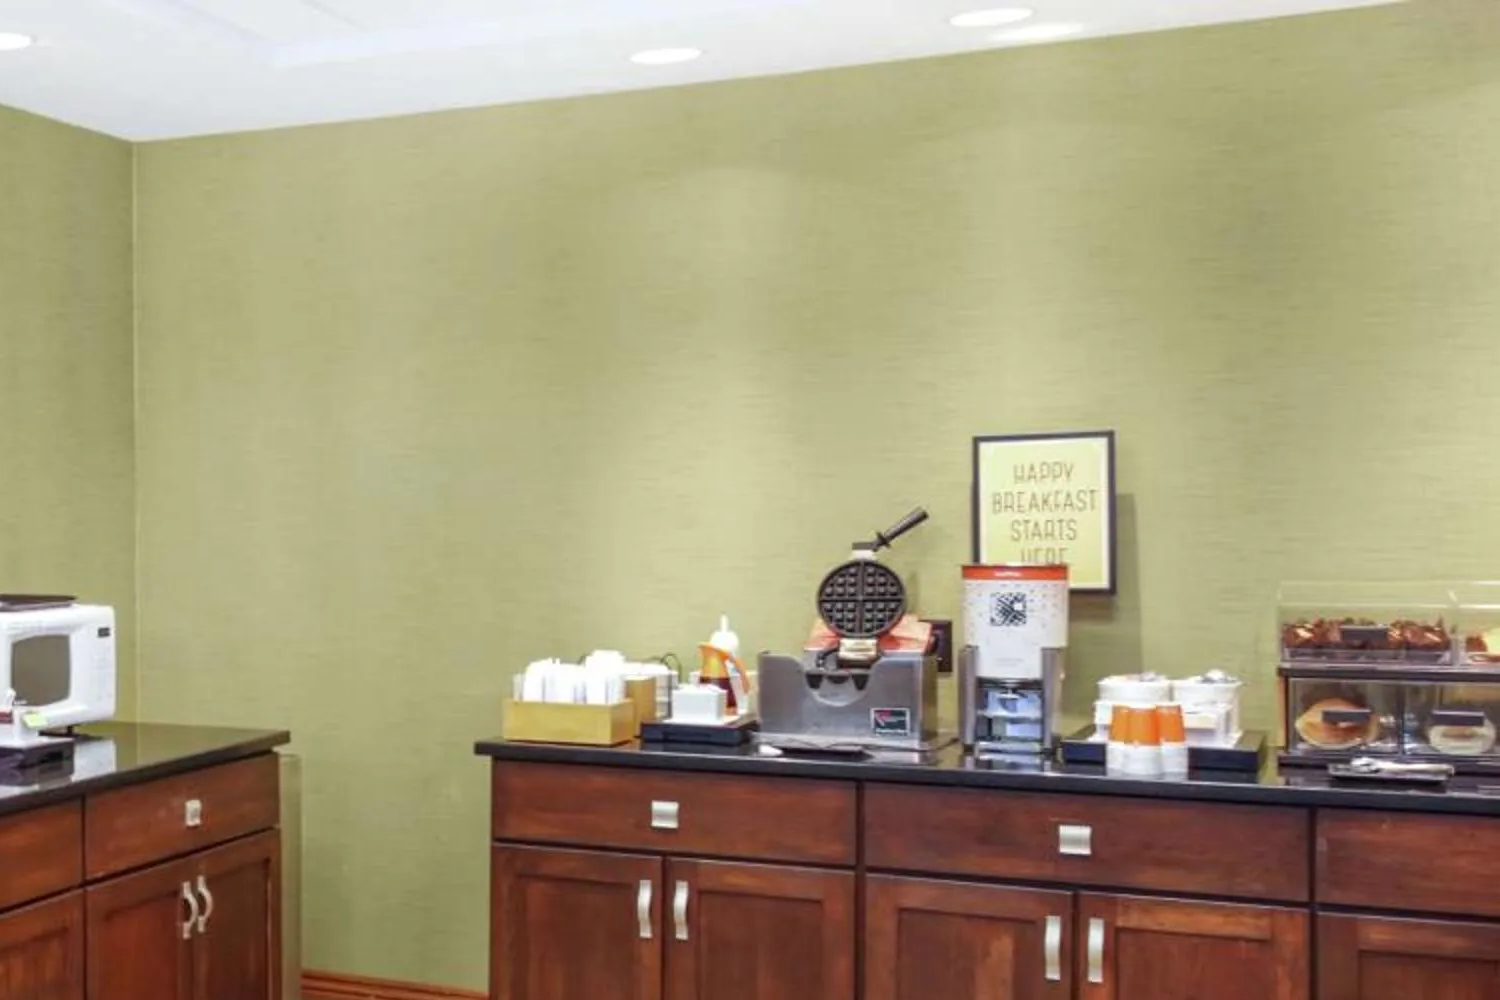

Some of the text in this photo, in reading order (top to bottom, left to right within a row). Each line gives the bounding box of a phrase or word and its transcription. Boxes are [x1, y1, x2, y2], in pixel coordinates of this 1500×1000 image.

[1013, 461, 1074, 484] HAPPY
[992, 489, 1097, 514] BREAKFAST
[1011, 518, 1077, 541] STARTS
